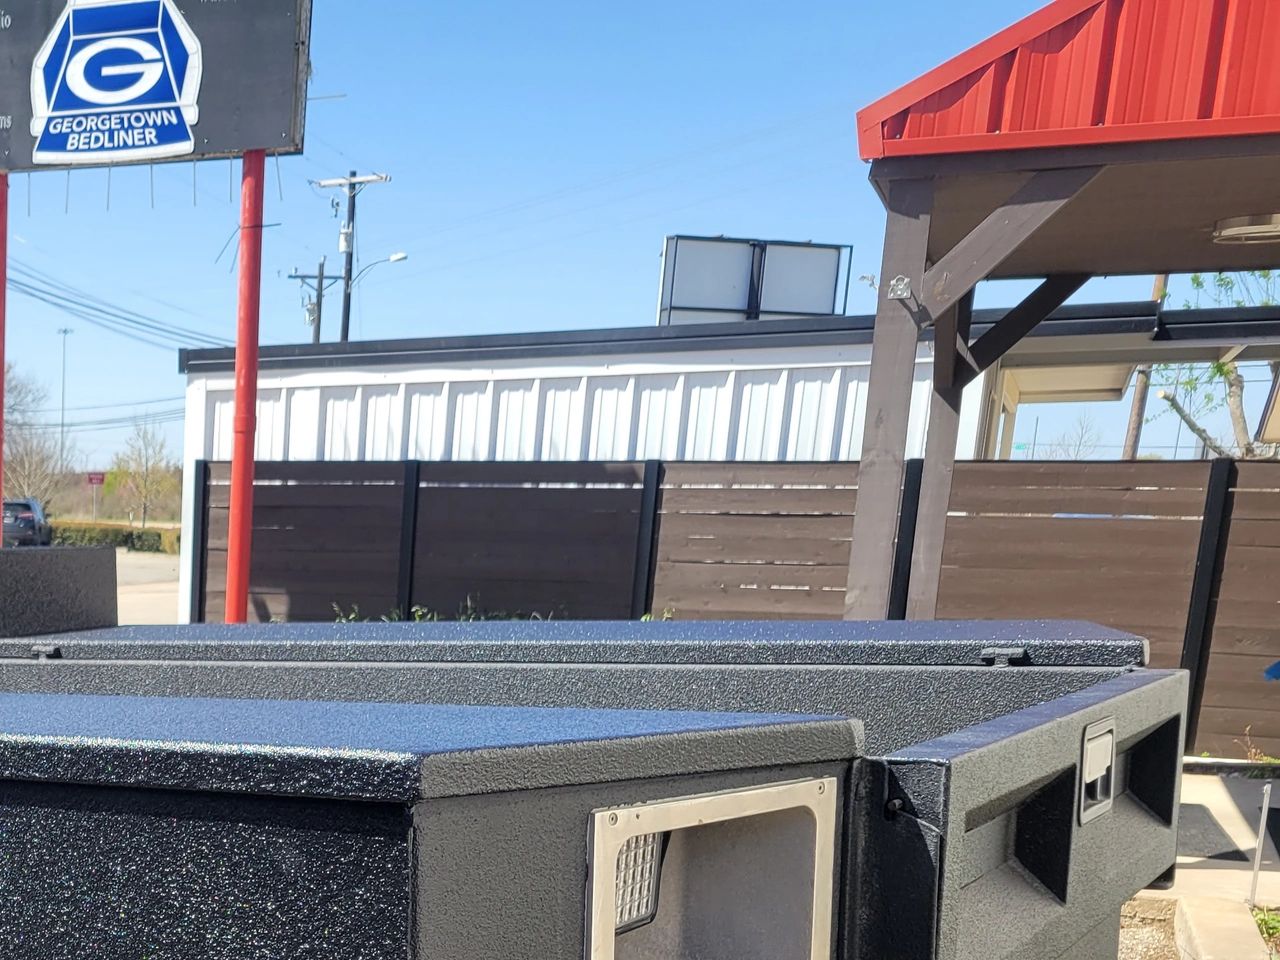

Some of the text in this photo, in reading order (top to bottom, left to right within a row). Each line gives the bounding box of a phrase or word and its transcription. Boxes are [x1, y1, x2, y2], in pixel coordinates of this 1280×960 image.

[65, 37, 164, 105] G
[48, 109, 178, 134] GEORGETOWN
[66, 128, 159, 151] BEDLINER
